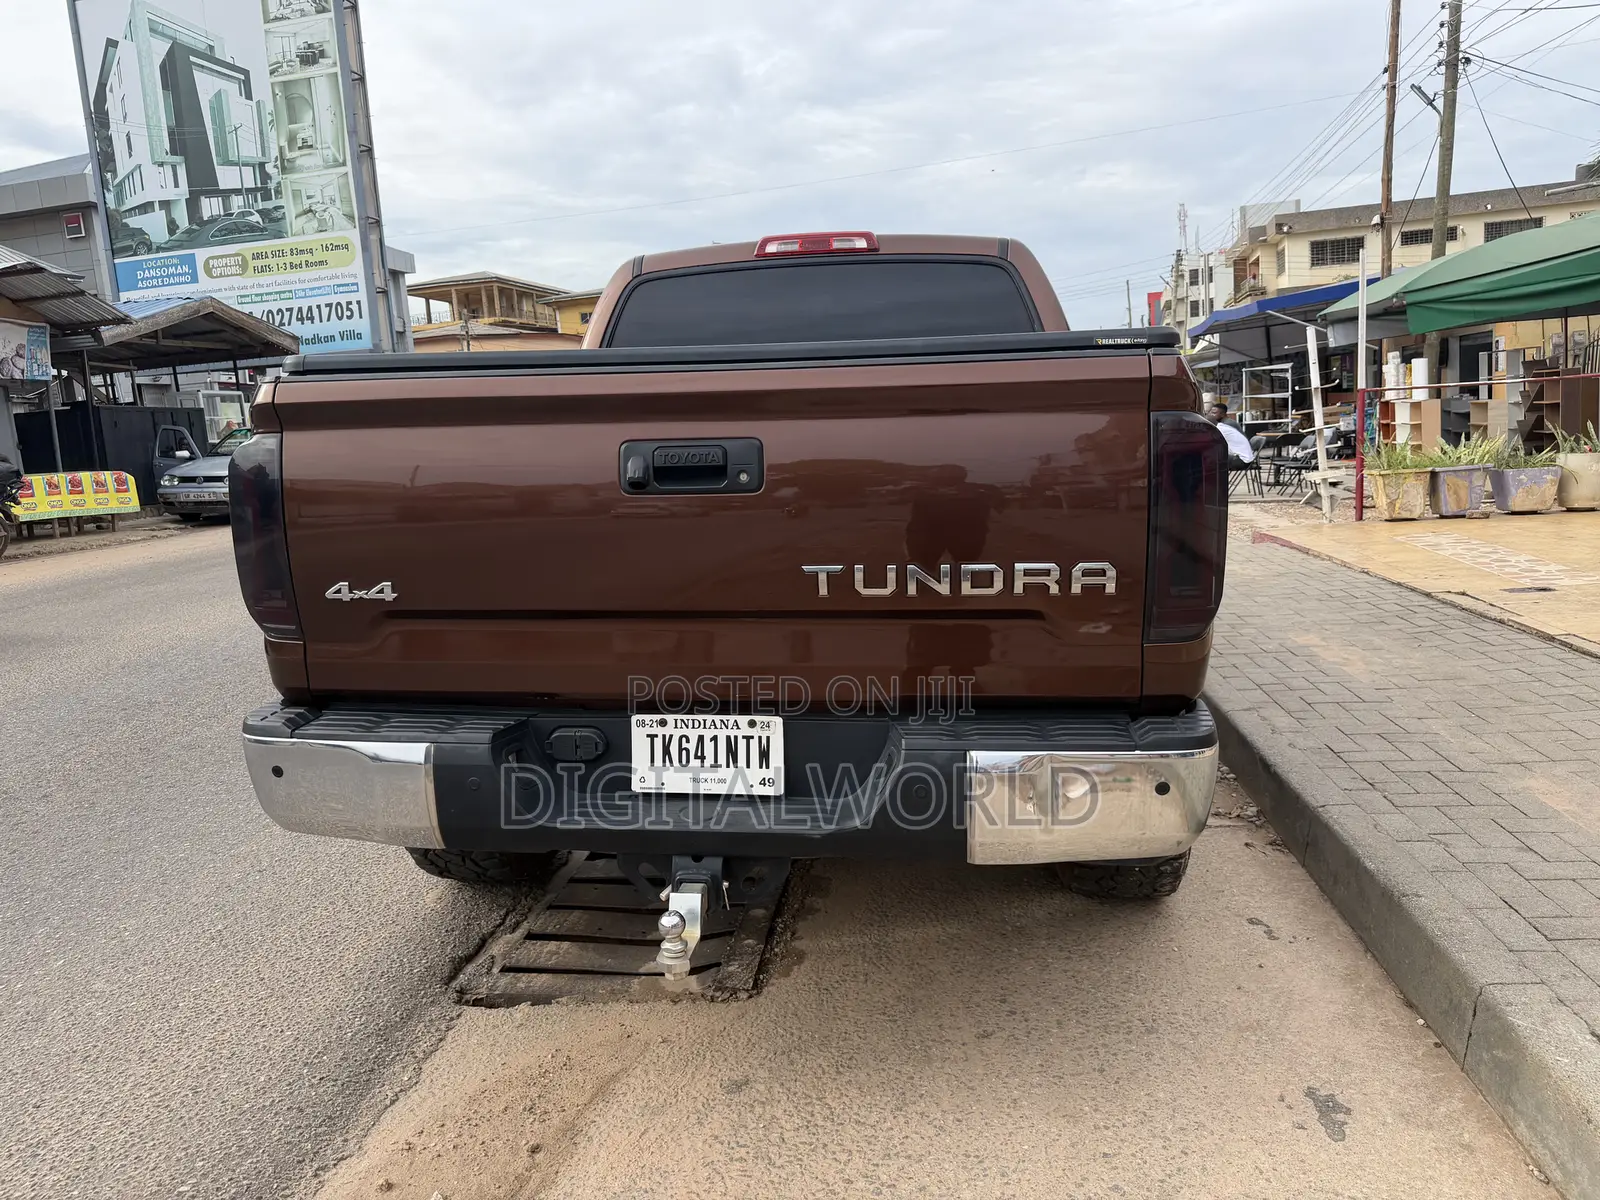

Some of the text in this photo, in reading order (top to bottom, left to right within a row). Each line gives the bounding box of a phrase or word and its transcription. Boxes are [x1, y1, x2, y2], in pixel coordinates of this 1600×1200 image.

[251, 251, 270, 261] AREA
[270, 249, 288, 259] SIZE:
[289, 247, 314, 257] 83msq
[320, 243, 349, 253] 162msq
[143, 257, 180, 269] LOCATION:
[209, 256, 242, 268] PROPERTY
[253, 259, 329, 274] FLATS: 1-3 Bed Rooms
[137, 264, 192, 279] DANSOMAN,
[212, 266, 242, 277] OPTIONS:
[256, 281, 265, 289] the
[275, 278, 298, 287] facilities
[298, 277, 307, 285] for
[307, 274, 341, 284] comfortable
[341, 272, 358, 280] living
[338, 329, 363, 342] Villa
[659, 452, 720, 464] TOYOTA
[801, 561, 1117, 597] TUNDRA
[325, 581, 398, 601] 4x4
[635, 718, 659, 728] 08-21
[673, 718, 742, 730] INDIANA
[759, 720, 771, 729] 24
[646, 733, 771, 769] TK641NTW
[709, 777, 727, 785] 11,000
[758, 777, 776, 787] 49
